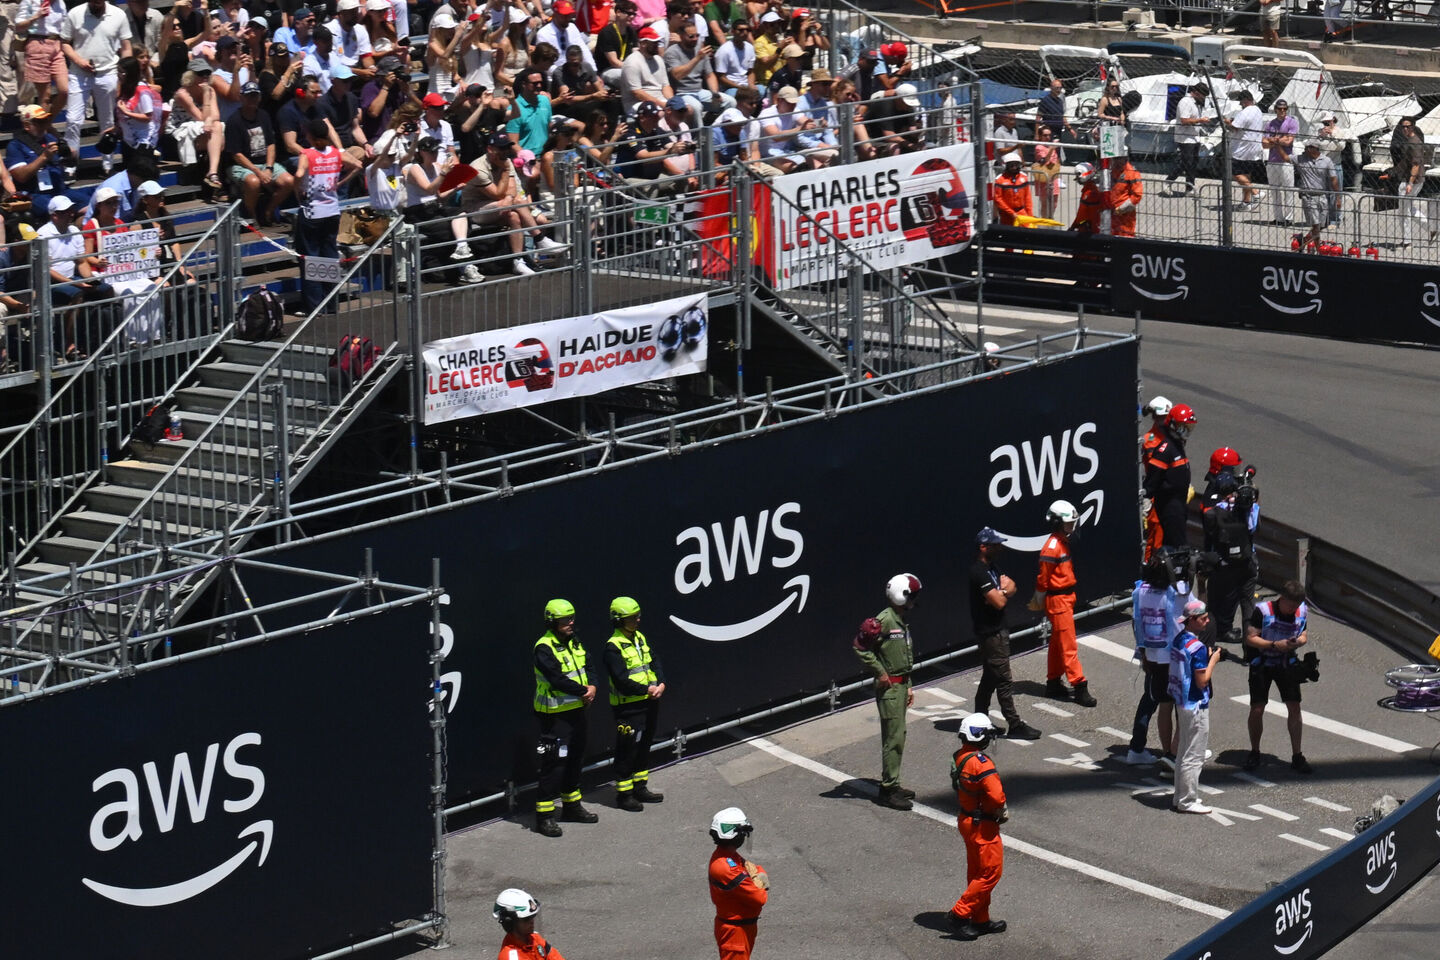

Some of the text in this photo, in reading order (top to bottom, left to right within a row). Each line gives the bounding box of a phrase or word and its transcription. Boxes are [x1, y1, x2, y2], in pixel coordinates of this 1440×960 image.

[796, 168, 900, 212] CHARLES
[136, 230, 158, 241] NEED
[781, 198, 898, 251] LECLERC
[880, 244, 905, 258] CLUB
[1131, 254, 1186, 281] aws
[1262, 266, 1319, 295] aws
[560, 324, 653, 357] HAI DUE
[438, 345, 506, 372] CHARLES
[558, 345, 657, 378] D'ACCIAIO
[429, 363, 504, 395] LECLERC
[436, 398, 468, 409] MARCHE
[490, 390, 509, 400] CLUB
[989, 423, 1098, 508] aws
[675, 502, 803, 595] aws
[90, 733, 266, 852] aws
[1367, 830, 1396, 876] aws
[1276, 888, 1312, 936] aws
